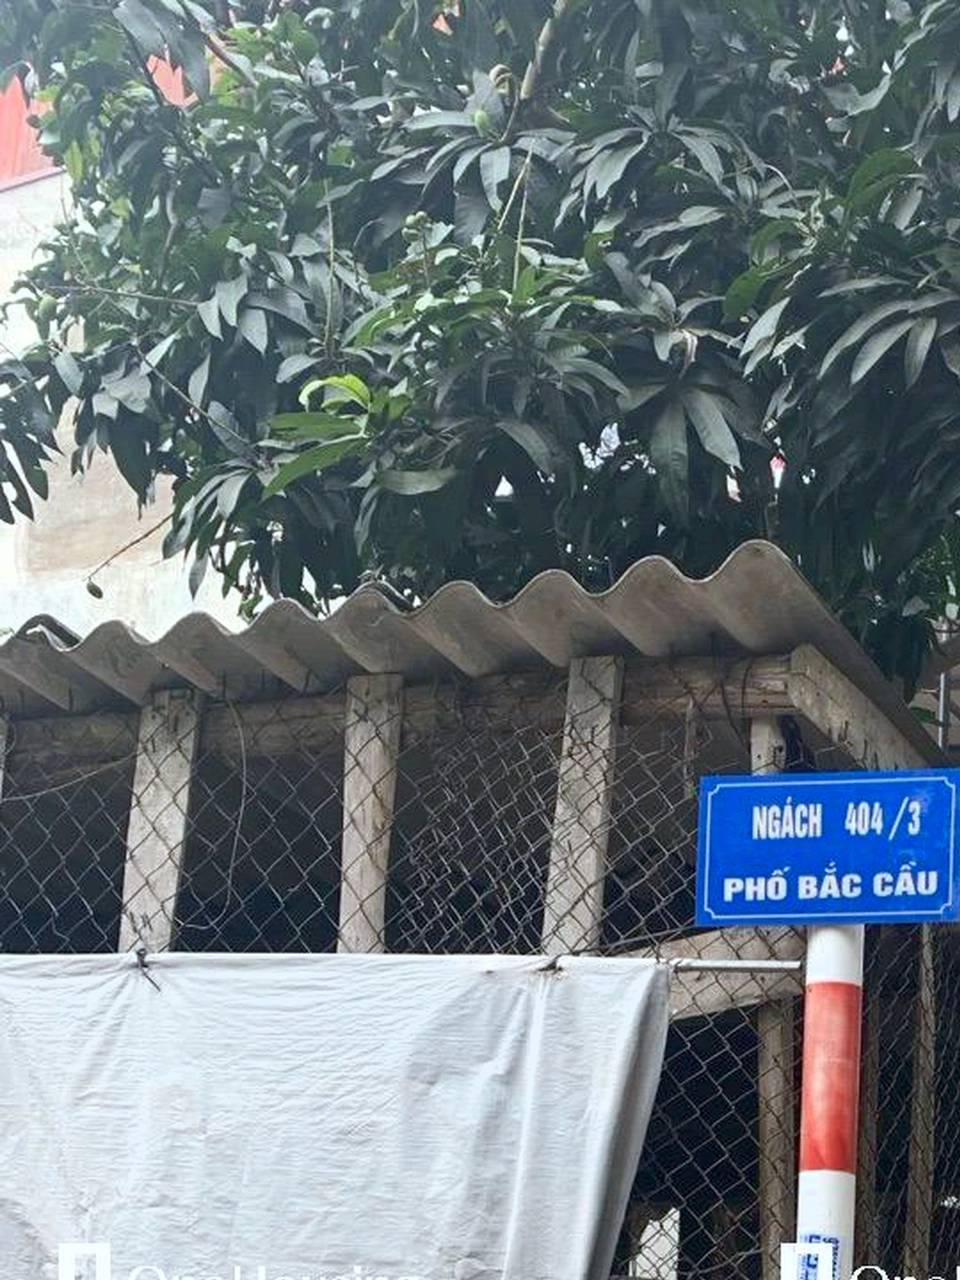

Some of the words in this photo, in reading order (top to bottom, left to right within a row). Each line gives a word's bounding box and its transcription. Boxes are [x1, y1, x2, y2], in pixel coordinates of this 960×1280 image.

[752, 796, 823, 840] NGÁCH
[723, 866, 791, 902] PHỐ
[797, 861, 862, 899] BẮC
[872, 860, 939, 898] CẦU
